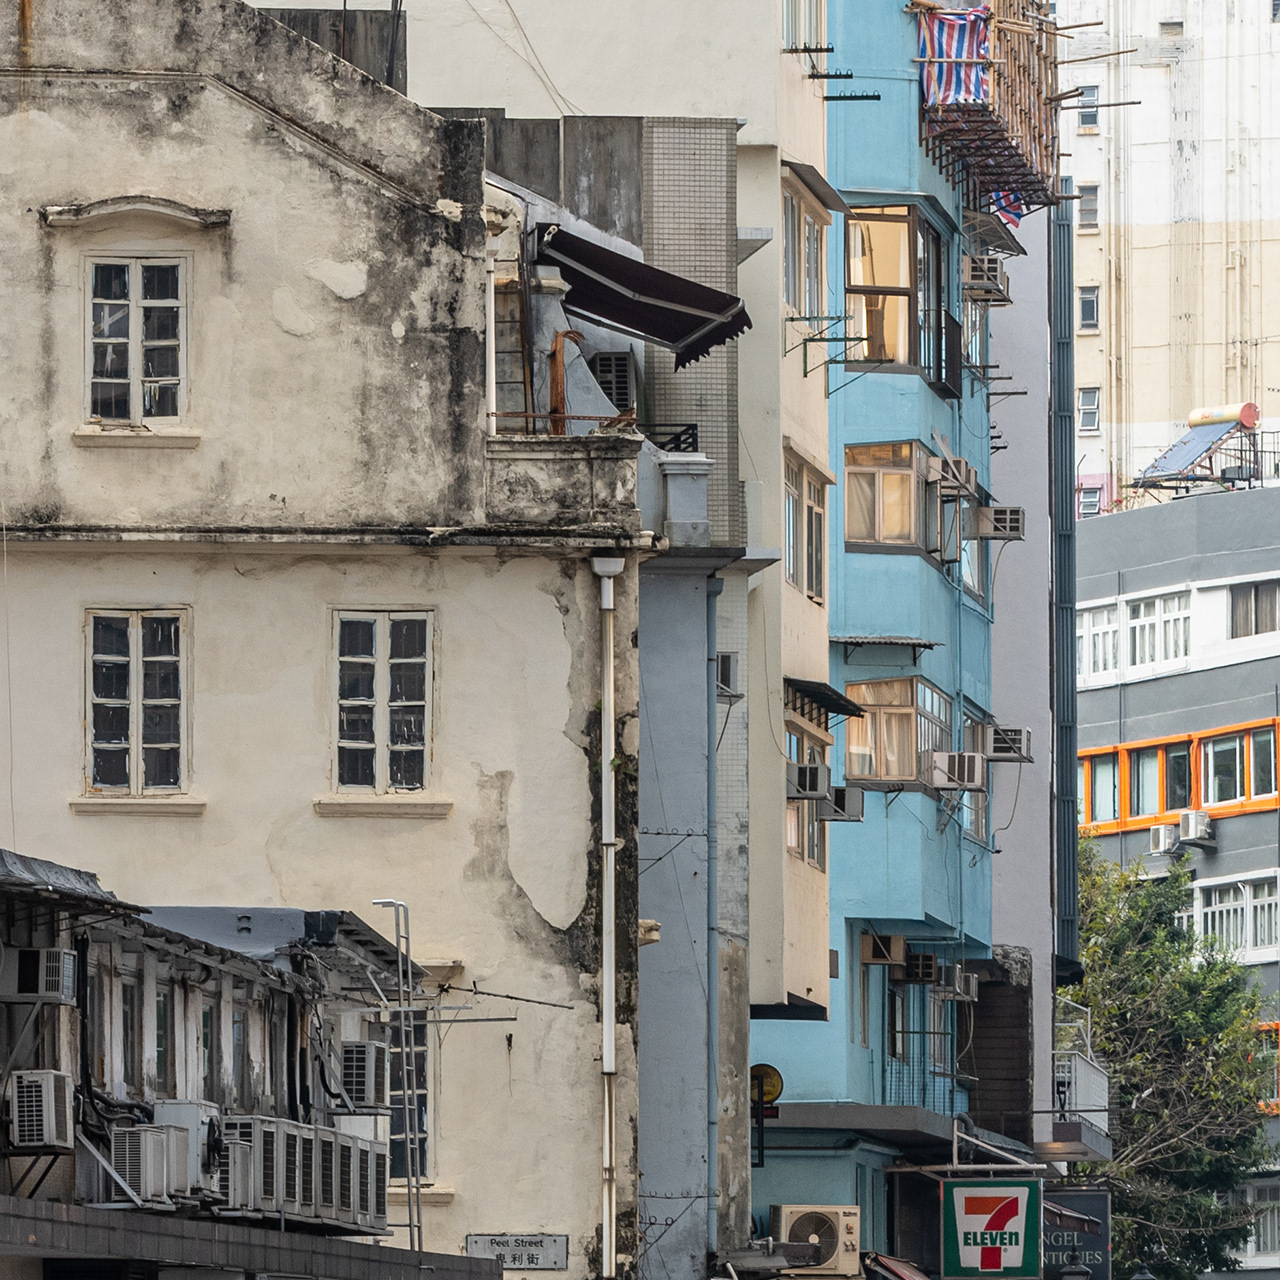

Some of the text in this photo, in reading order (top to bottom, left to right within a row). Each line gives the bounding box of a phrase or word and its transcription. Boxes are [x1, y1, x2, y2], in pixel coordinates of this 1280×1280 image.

[964, 1196, 1019, 1271] 7
[1043, 1232, 1083, 1246] NGEL
[490, 1238, 544, 1248] Peel Street
